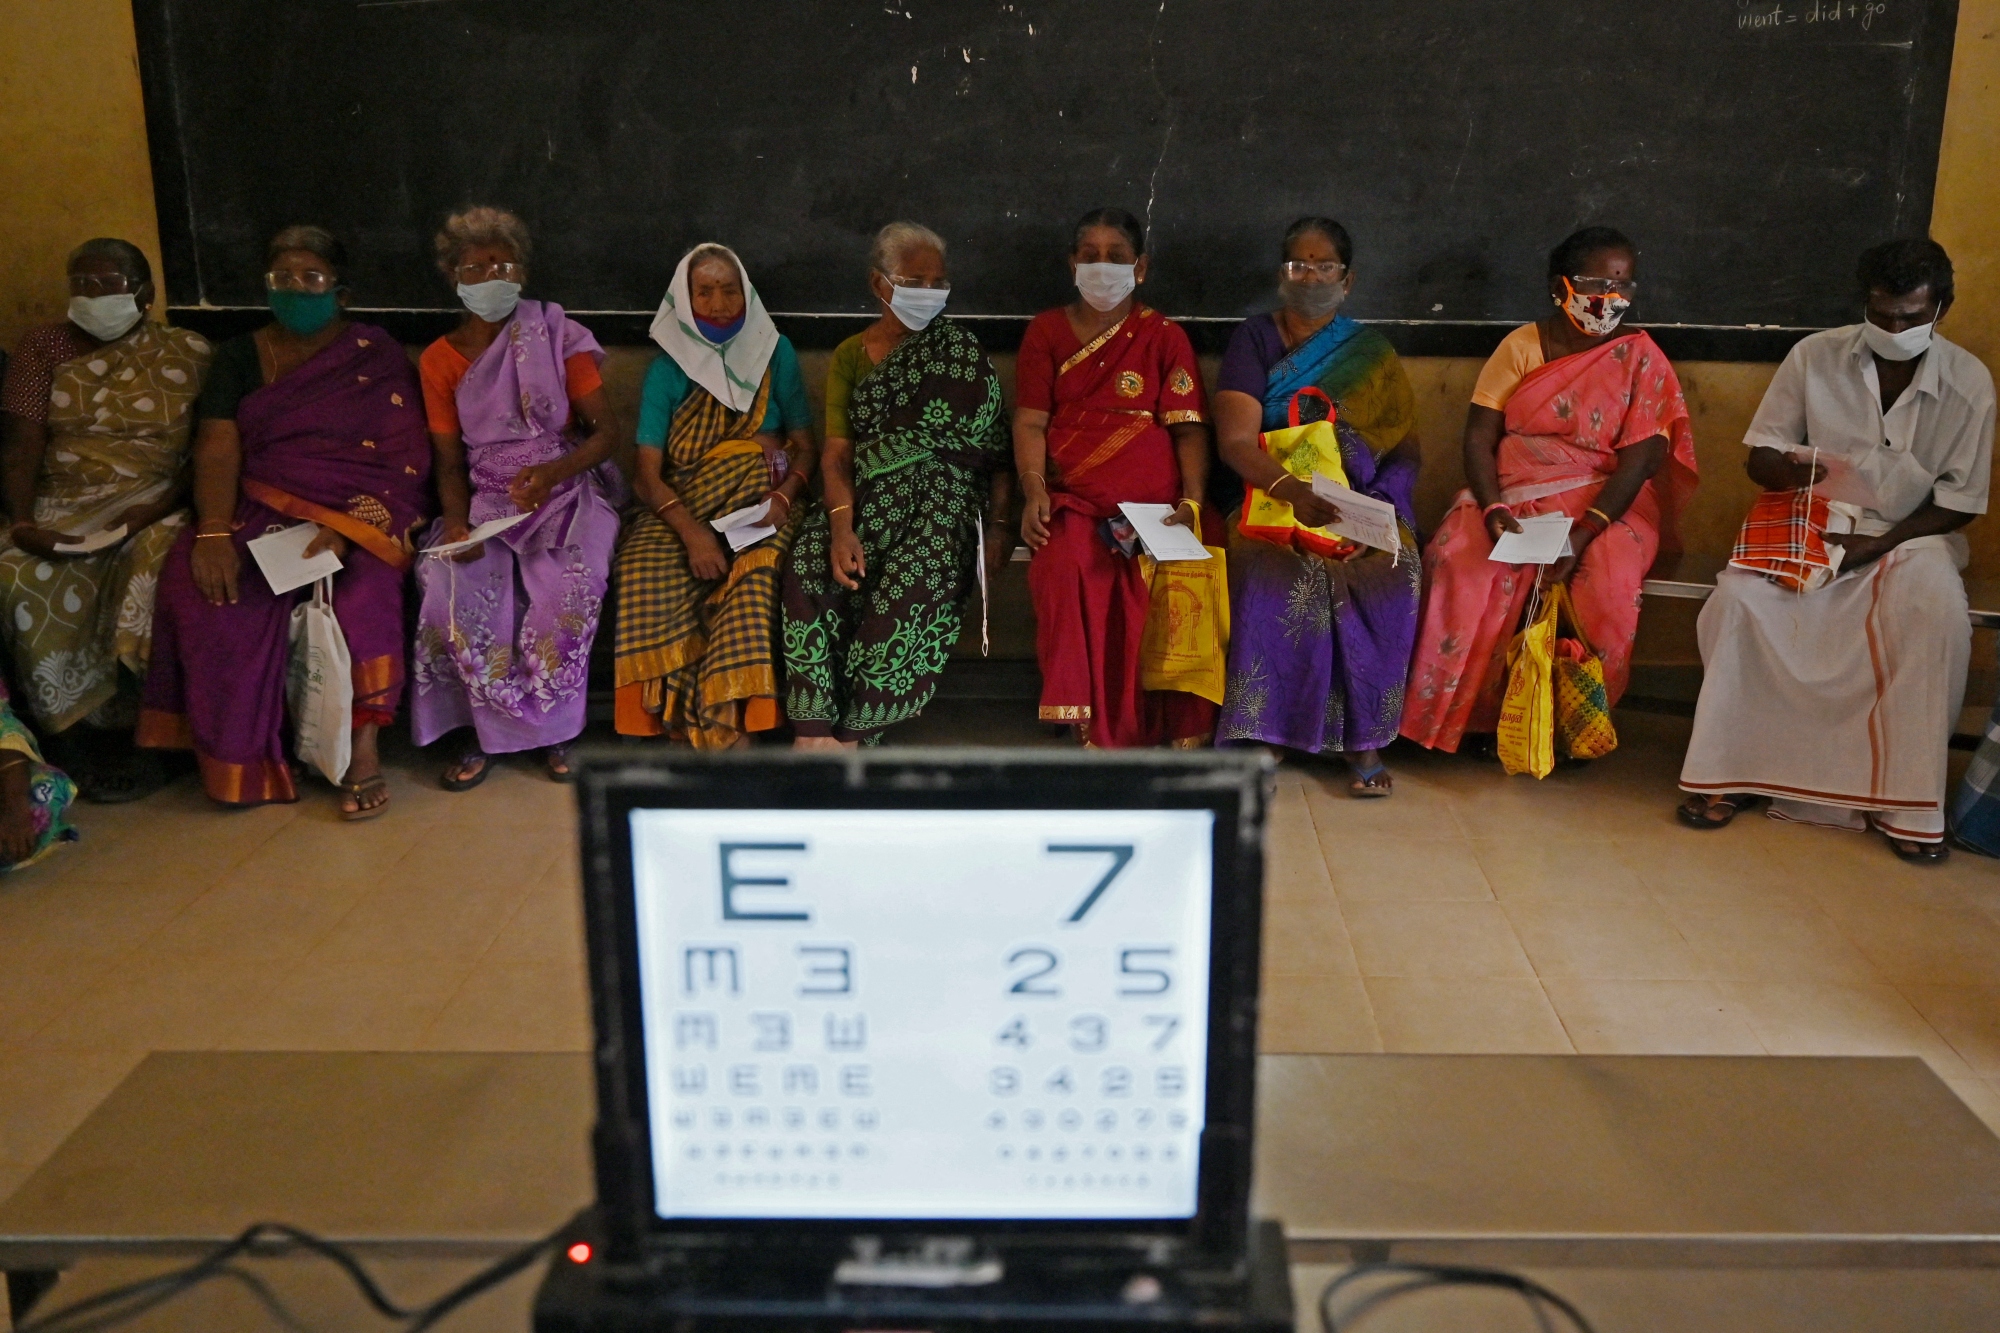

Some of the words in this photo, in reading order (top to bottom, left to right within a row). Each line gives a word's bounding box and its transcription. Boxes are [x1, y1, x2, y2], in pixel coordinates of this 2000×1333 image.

[1806, 0, 1841, 23] did
[1861, 3, 1886, 31] go
[719, 842, 808, 921] E
[1047, 844, 1134, 922] 7
[1008, 948, 1057, 994] 2
[1120, 948, 1171, 994] 5
[996, 1016, 1030, 1050] 4
[1068, 1014, 1109, 1052] 3
[1143, 1014, 1182, 1050] 7
